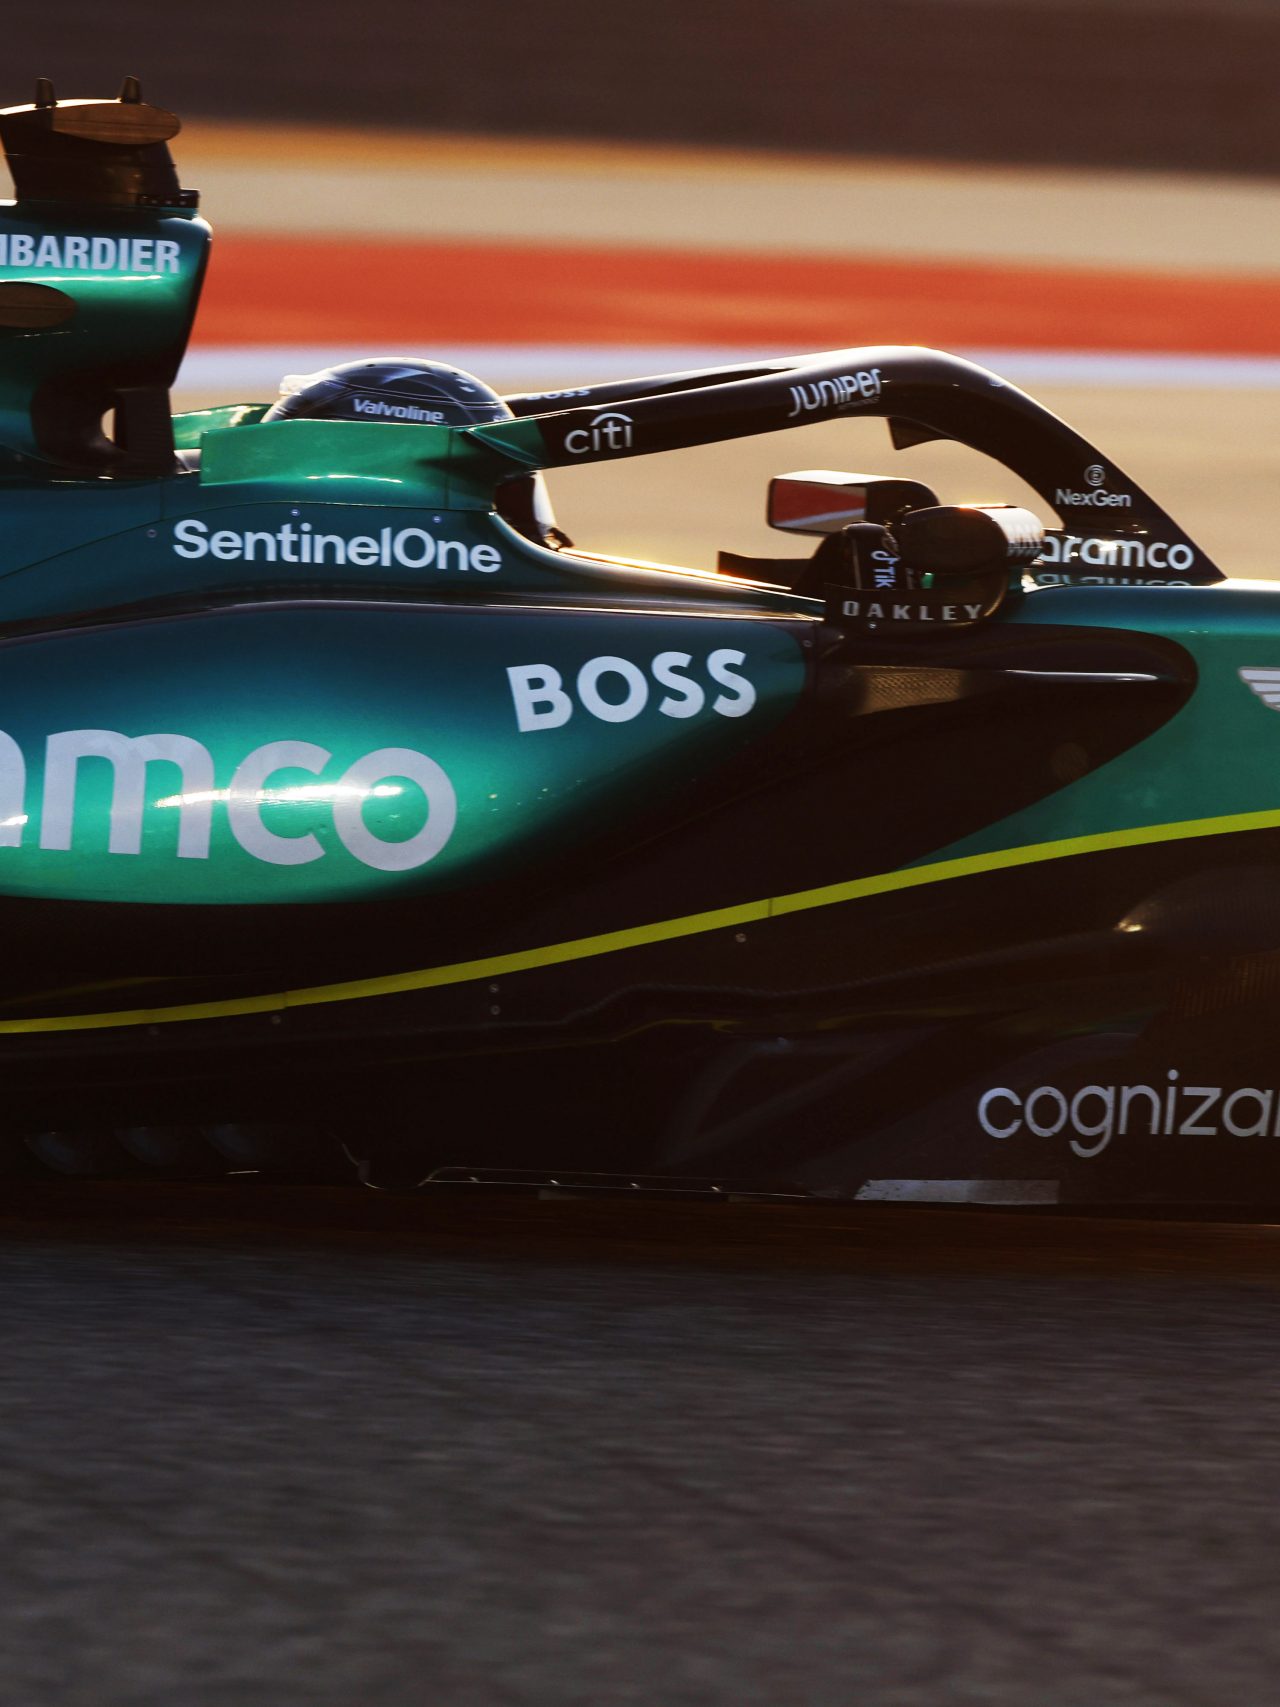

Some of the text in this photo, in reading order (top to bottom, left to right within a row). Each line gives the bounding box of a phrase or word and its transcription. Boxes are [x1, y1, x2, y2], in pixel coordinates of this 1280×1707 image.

[352, 398, 446, 424] Valvoline
[564, 412, 634, 455] citi
[1055, 488, 1132, 508] NexGen
[173, 519, 502, 574] SentinelOne
[842, 600, 982, 621] OAKLEY
[506, 648, 757, 733] BOSS
[0, 728, 457, 872] mco
